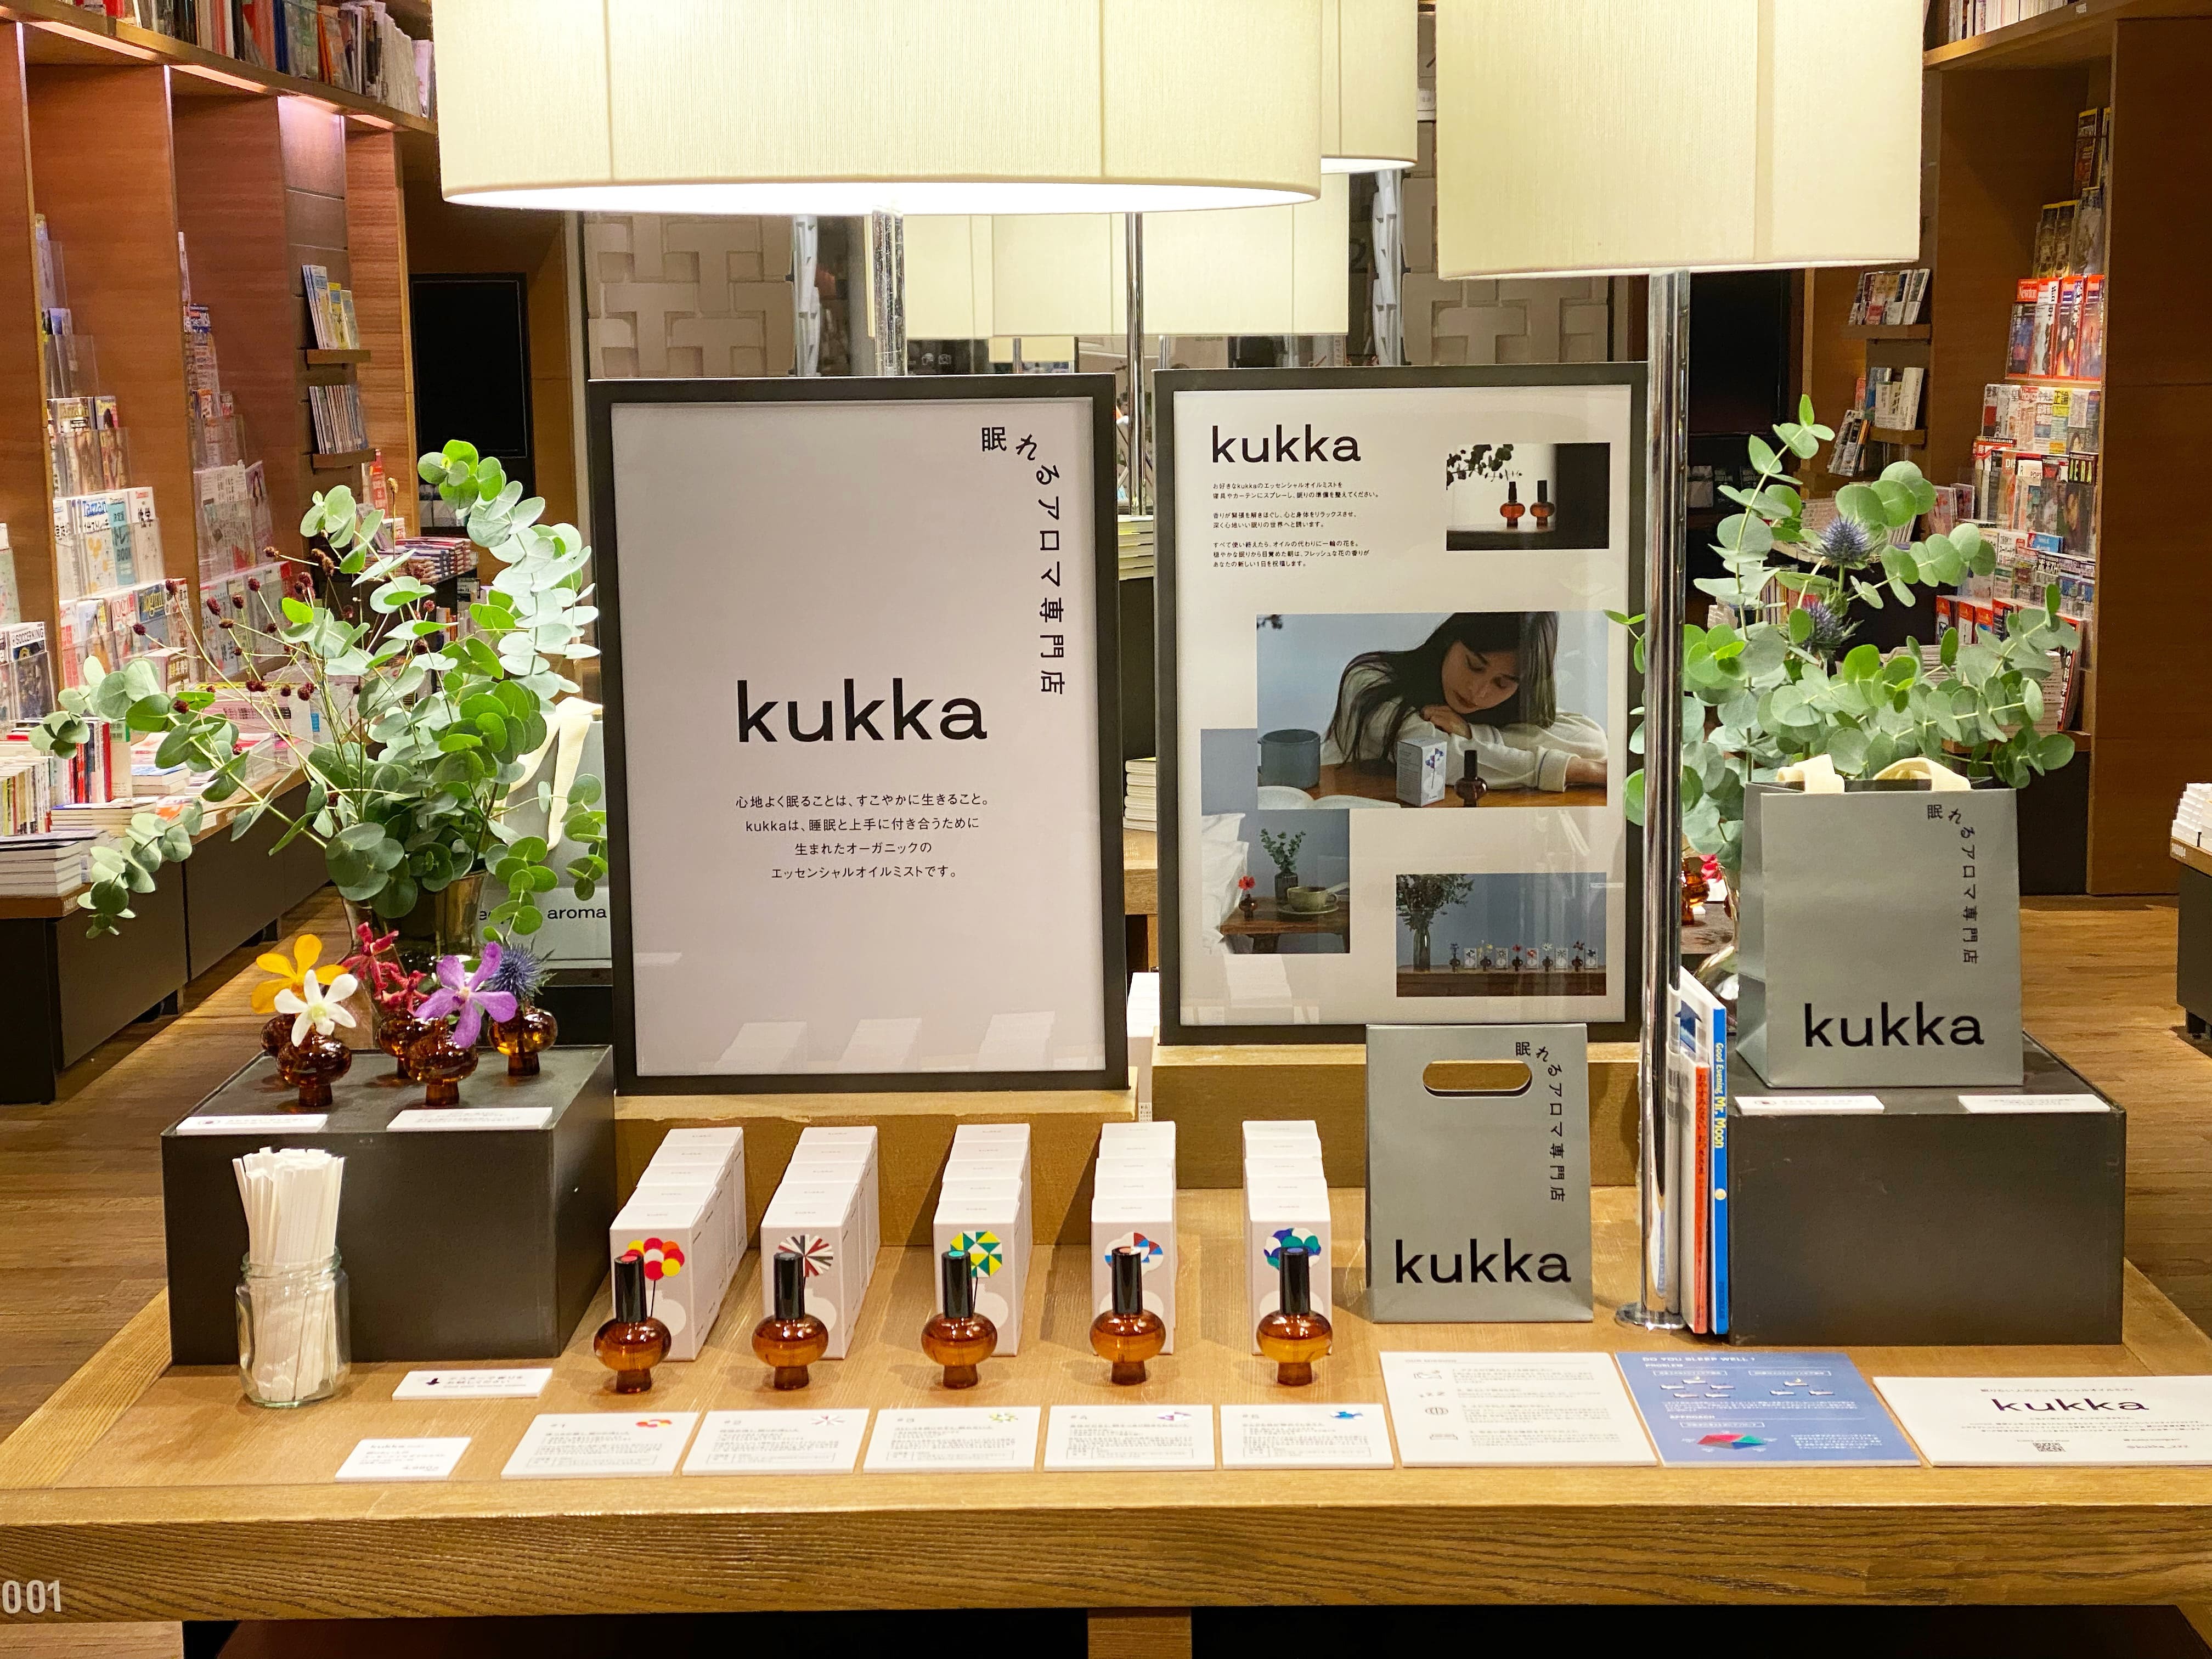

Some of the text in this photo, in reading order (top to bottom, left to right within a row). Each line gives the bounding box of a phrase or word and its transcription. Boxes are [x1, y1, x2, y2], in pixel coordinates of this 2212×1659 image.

[1213, 425, 1361, 463] kukka
[981, 426, 1065, 695] 眠れるアロマ専門店
[737, 678, 988, 743] kukka
[736, 793, 988, 809] 心地よく眠ることは、すこやかに生きること。
[745, 817, 979, 832] kukkaは、睡眠と上手に付き合うために
[794, 841, 932, 856] 生まれたオーガニックの
[771, 865, 956, 879] エッセンシャルオイルミストです。
[548, 909, 607, 919] aroma
[1804, 1001, 1985, 1047] kukka
[1714, 1042, 1726, 1149] Good Evening Mr. Moon
[1516, 1042, 1566, 1202] 眠れるアロマ専門店
[1396, 1238, 1572, 1284] kukka
[1991, 1398, 2149, 1411] kukka
[2, 1579, 62, 1614] 001
